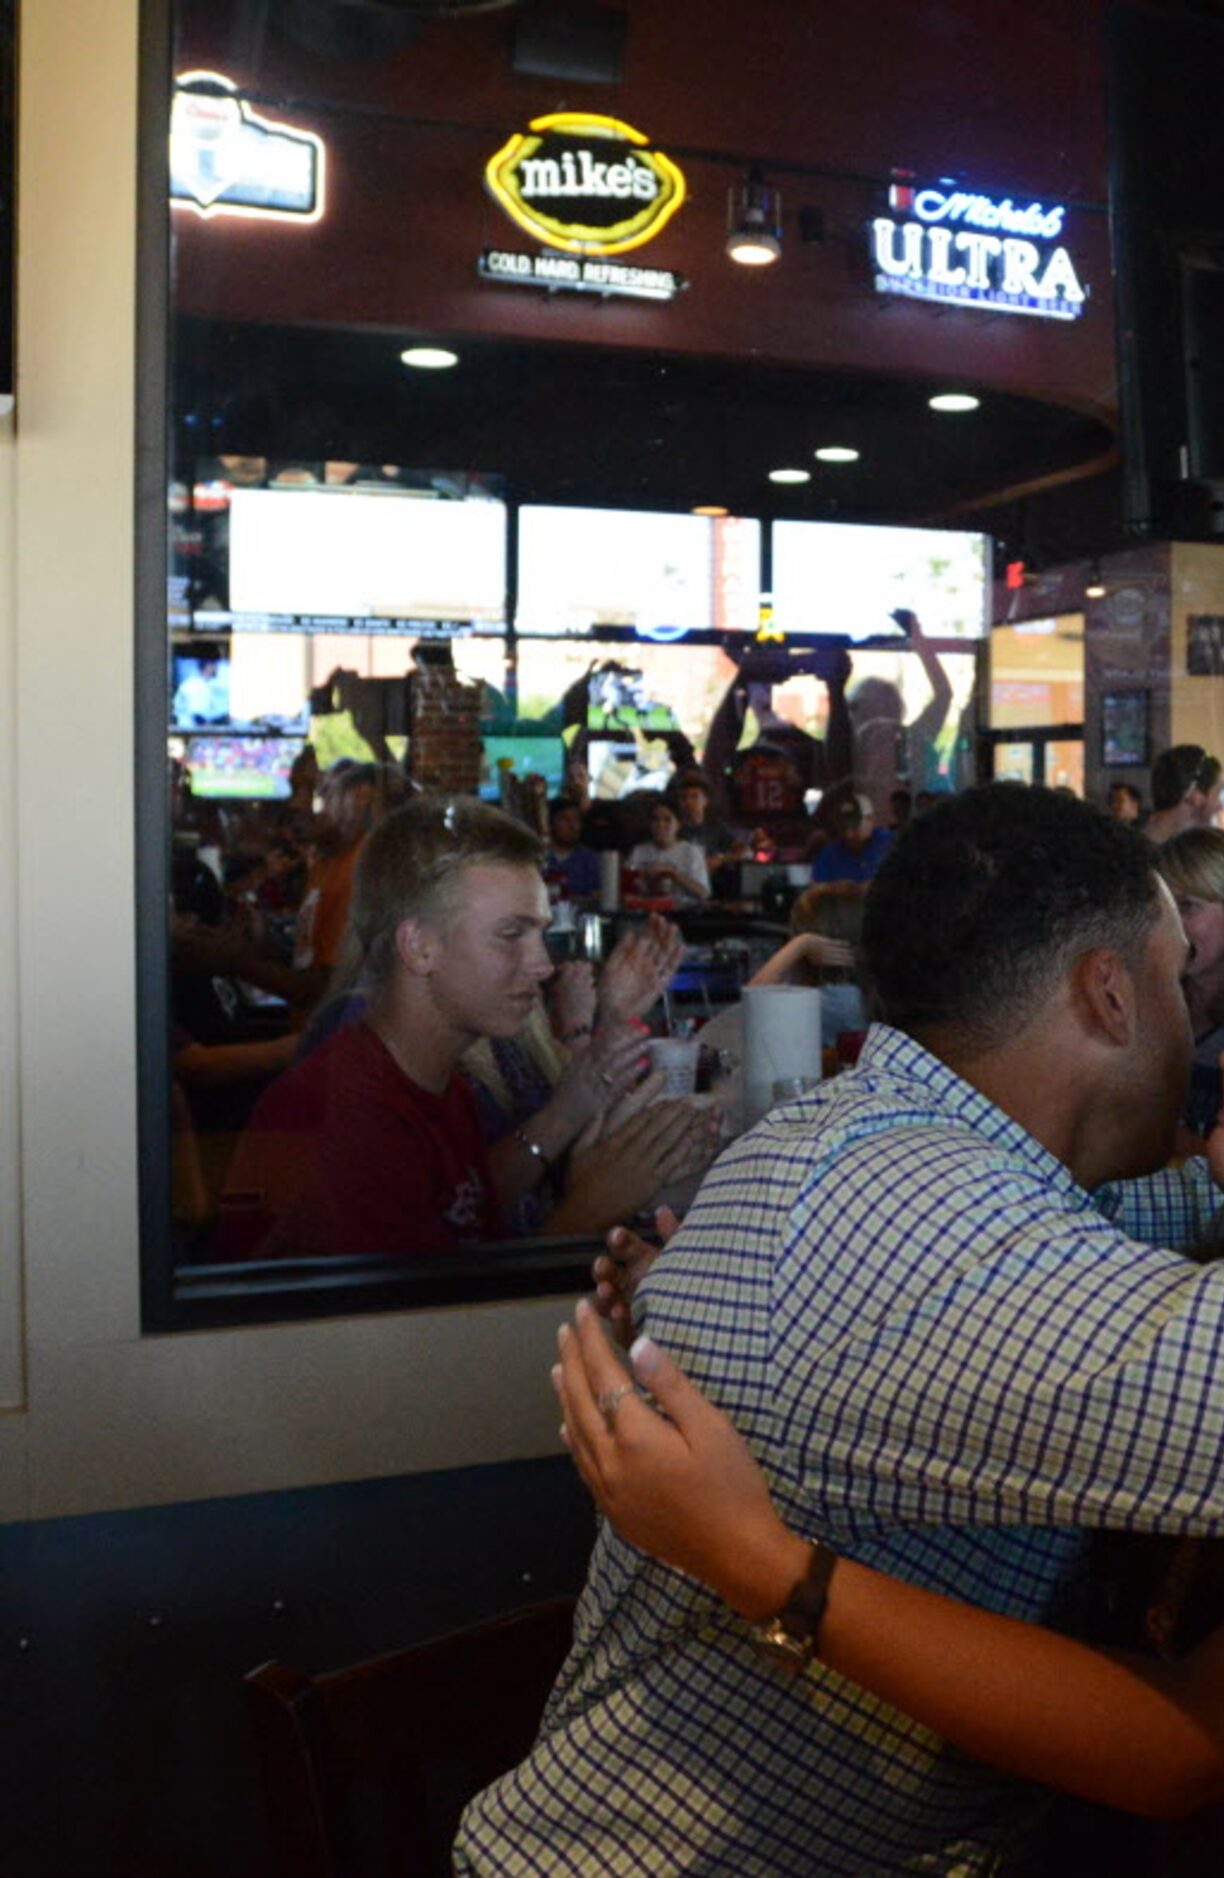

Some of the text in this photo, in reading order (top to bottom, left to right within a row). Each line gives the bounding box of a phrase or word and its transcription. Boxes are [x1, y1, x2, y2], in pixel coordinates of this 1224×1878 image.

[520, 150, 658, 199] mike's
[914, 190, 1065, 238] Michelob
[487, 252, 676, 289] COLD HARD REFRESHING
[873, 217, 1086, 302] ULTRA
